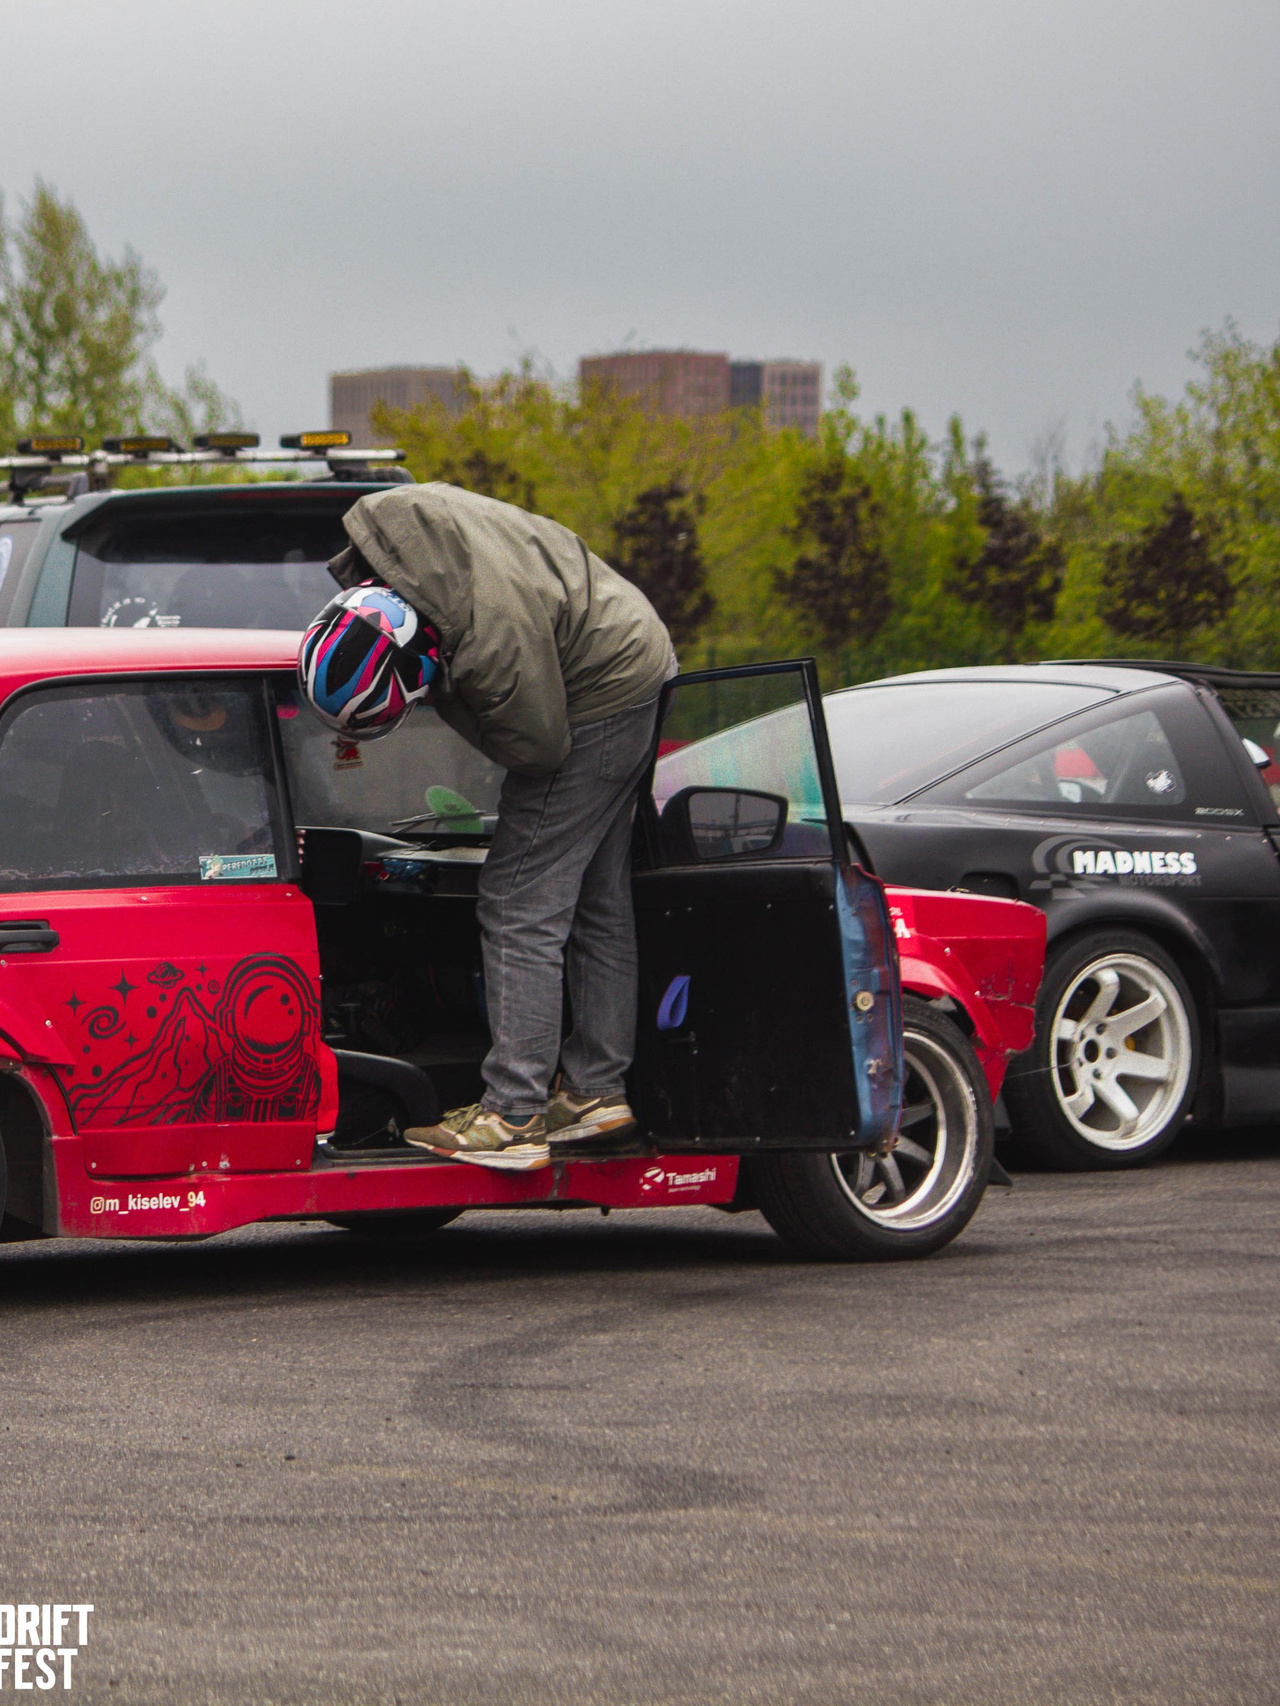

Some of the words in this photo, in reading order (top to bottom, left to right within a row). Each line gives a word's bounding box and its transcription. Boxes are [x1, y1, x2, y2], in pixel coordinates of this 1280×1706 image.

[1073, 850, 1197, 875] MADNESS
[666, 1167, 717, 1186] Tamashi
[105, 1190, 206, 1214] m_kiselev_94
